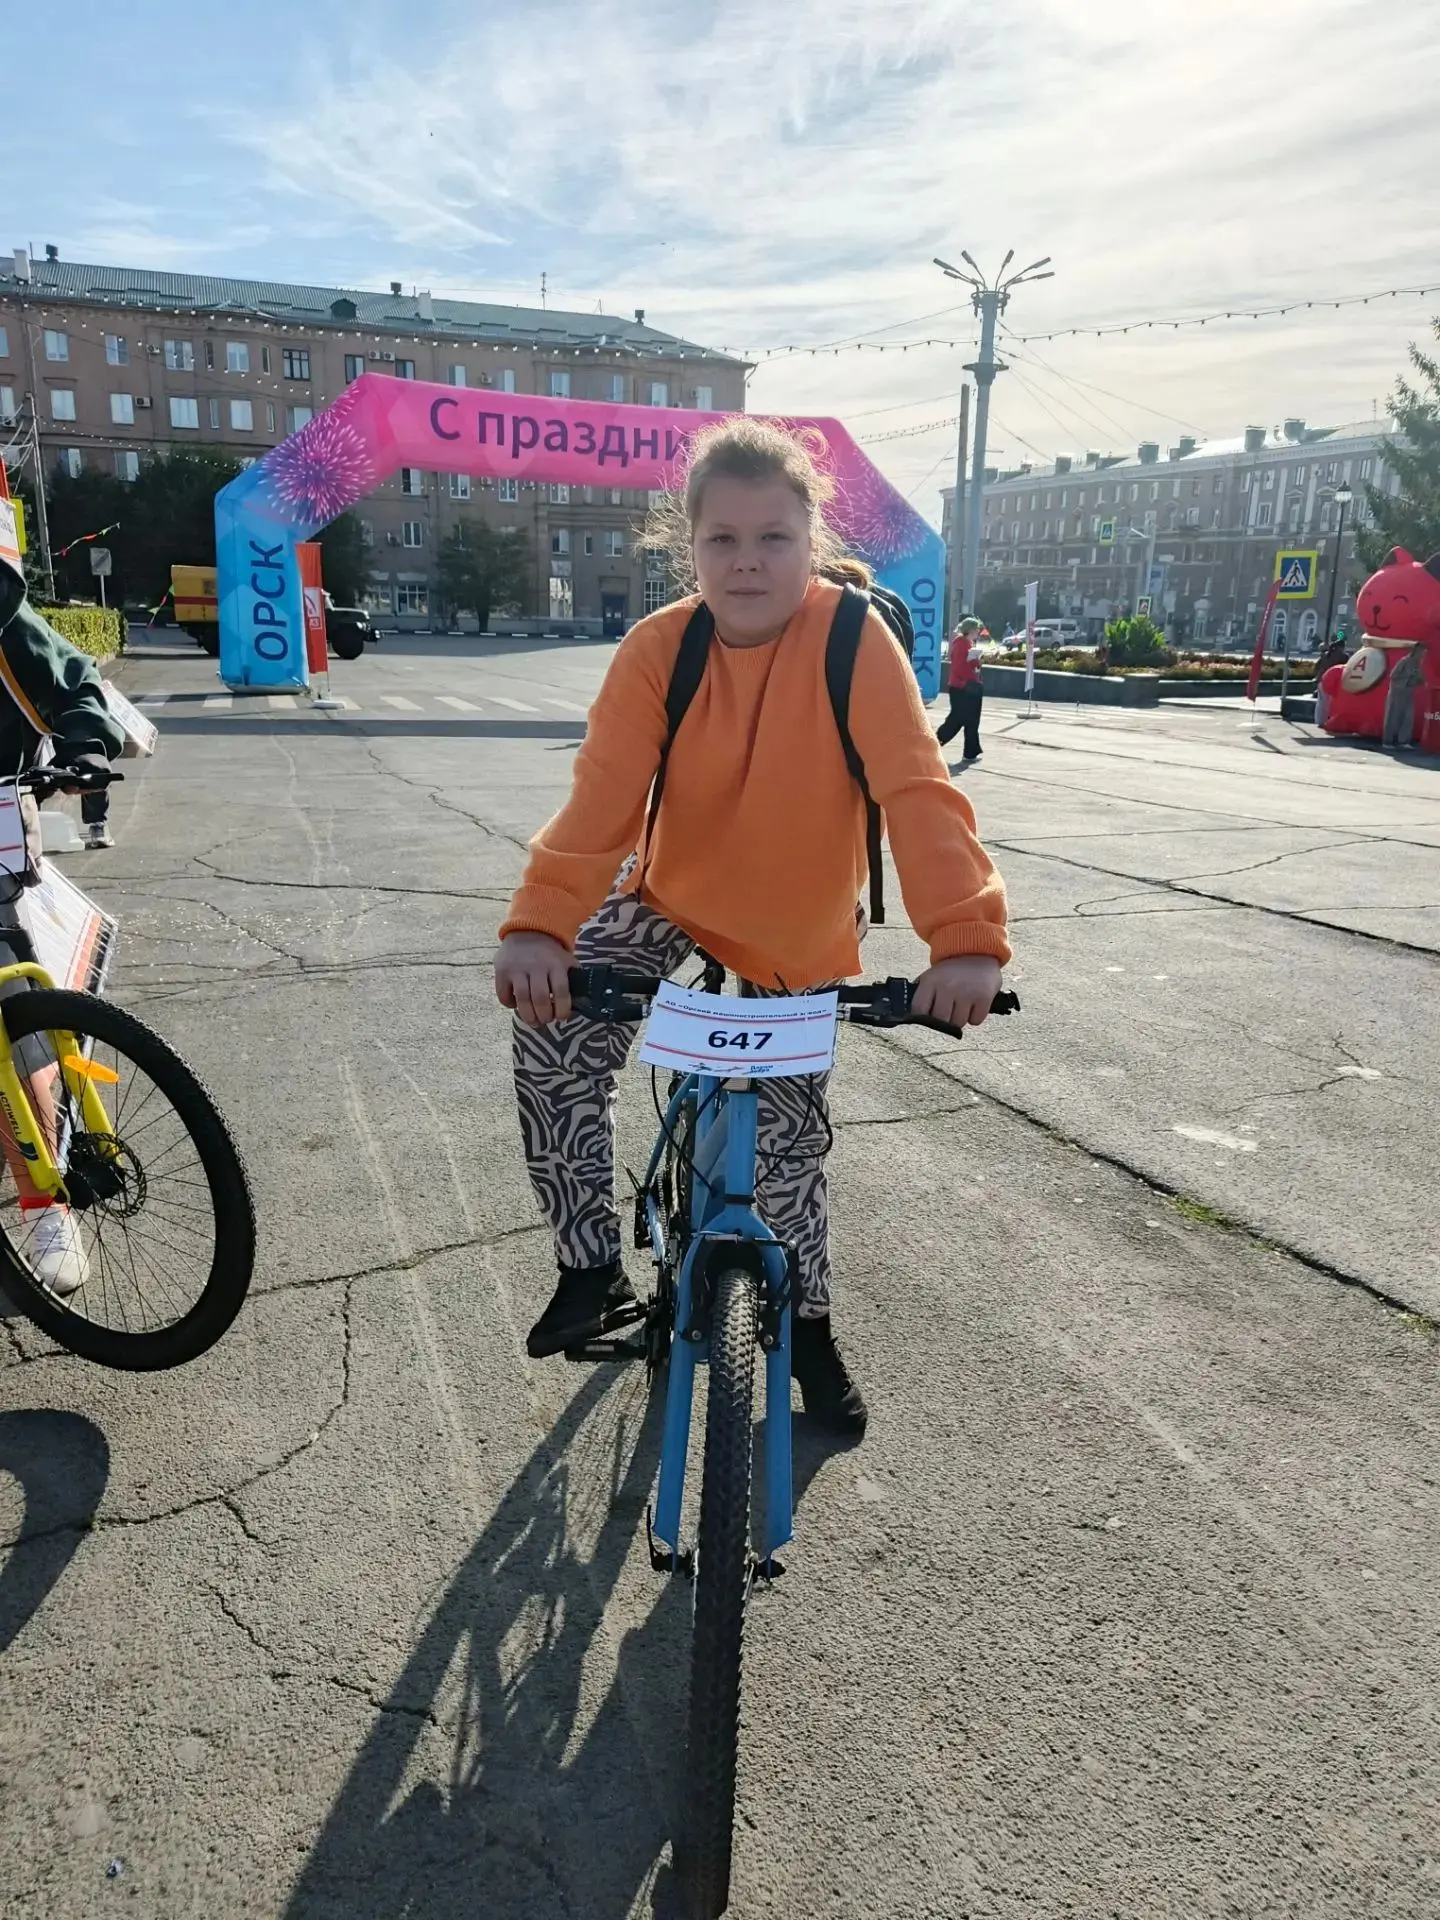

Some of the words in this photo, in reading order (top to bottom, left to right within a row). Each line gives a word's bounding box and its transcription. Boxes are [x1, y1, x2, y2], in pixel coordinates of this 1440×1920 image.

[430, 397, 461, 441] С
[478, 410, 691, 468] праздни
[249, 540, 289, 661] ОРСК
[911, 578, 936, 677] ОРСК
[708, 1030, 773, 1050] 647
